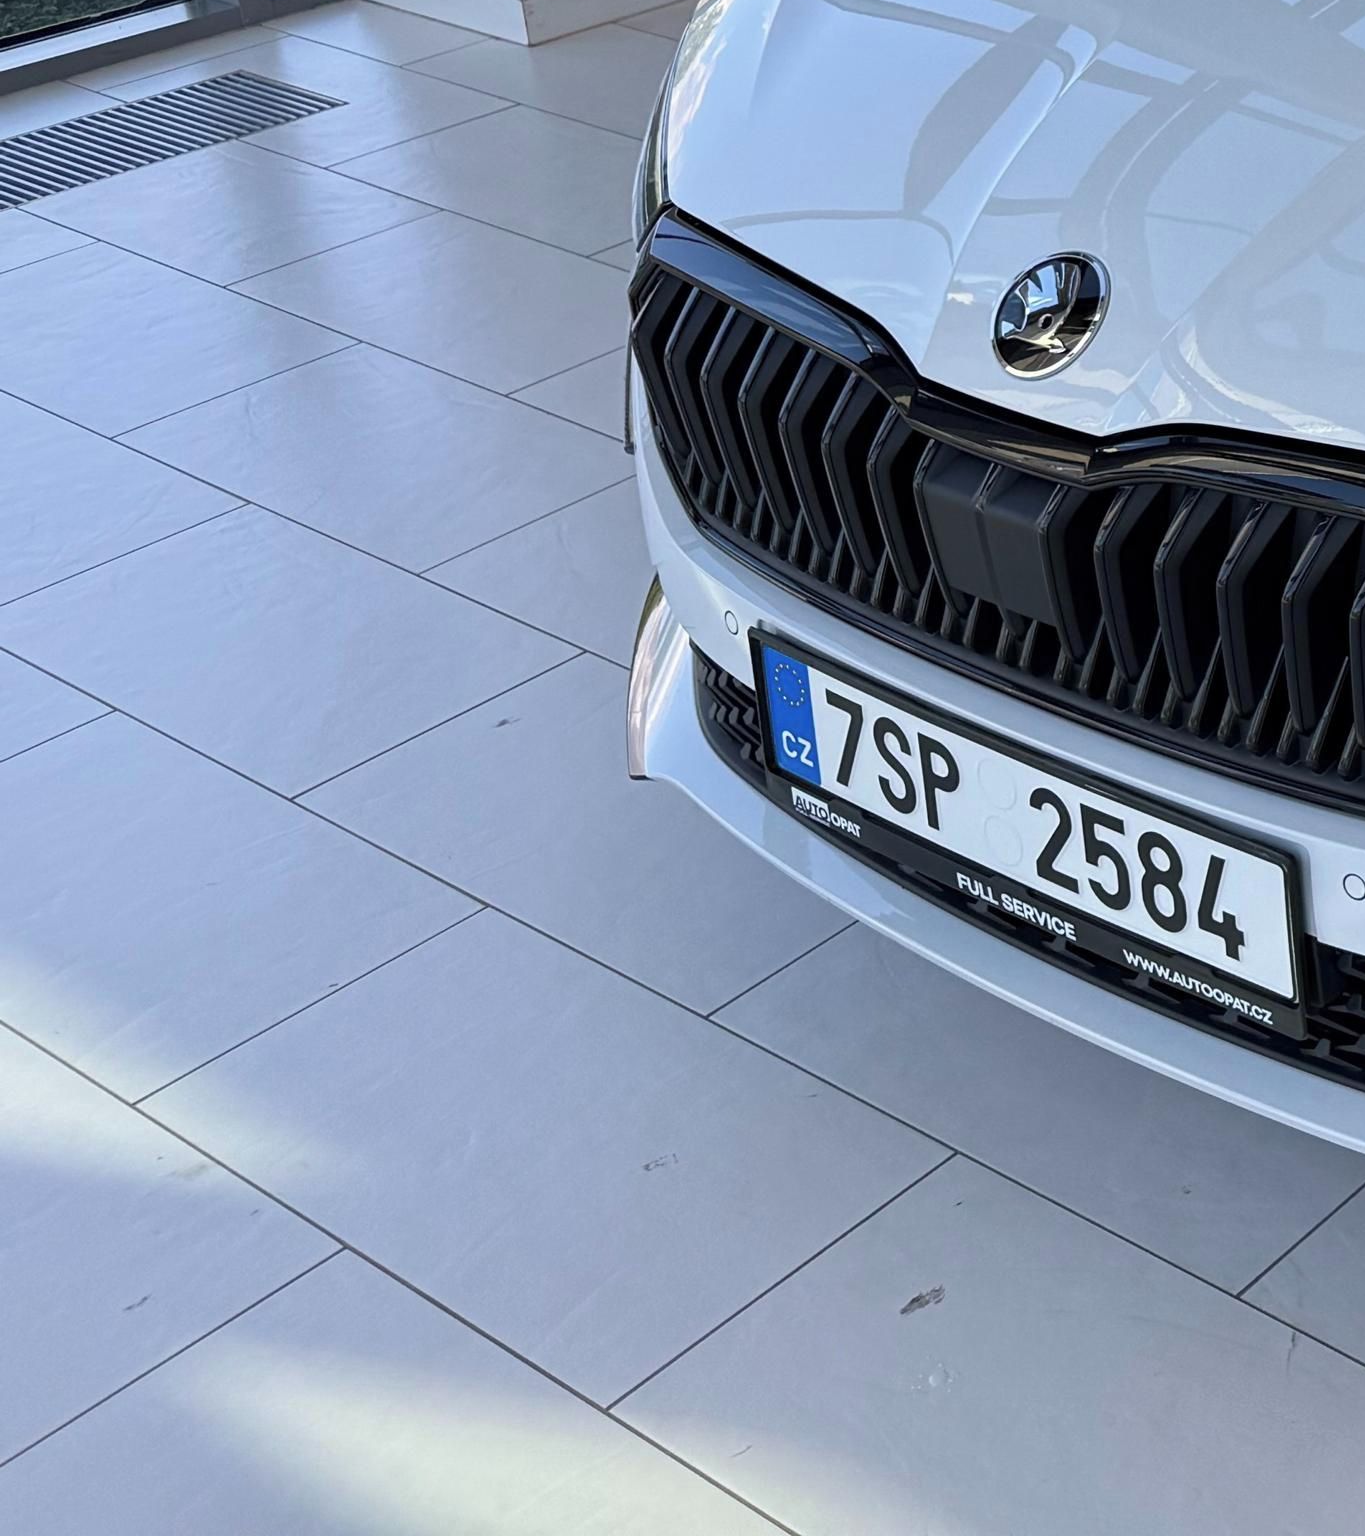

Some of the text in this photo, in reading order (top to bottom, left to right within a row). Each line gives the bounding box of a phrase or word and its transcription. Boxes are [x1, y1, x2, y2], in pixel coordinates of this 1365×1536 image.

[781, 729, 814, 768] CZ
[826, 689, 1244, 961] 7SP 2584
[956, 872, 1077, 941] FULL SERVICE
[1122, 949, 1274, 1025] WWW.AUTOOPAT.CZ
